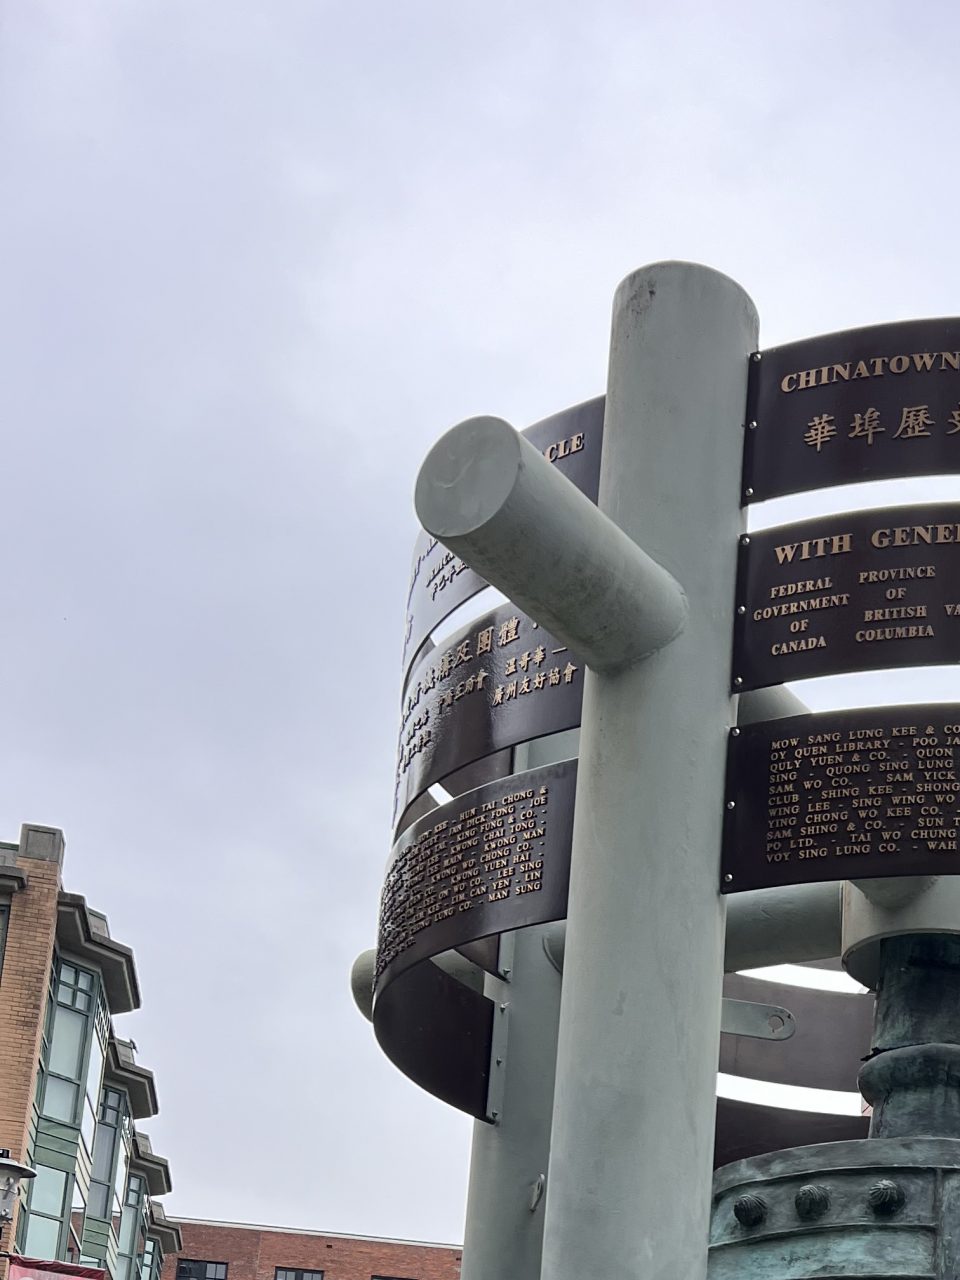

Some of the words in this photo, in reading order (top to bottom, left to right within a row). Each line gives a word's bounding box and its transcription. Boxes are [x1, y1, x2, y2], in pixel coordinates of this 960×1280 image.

[774, 533, 853, 565] WITH
[859, 565, 936, 584] PROVINCE
[770, 577, 833, 599] FEDERAL
[886, 588, 907, 600] OF
[753, 593, 850, 622] GOVERNMENT
[864, 605, 927, 622] BRITISH
[790, 619, 809, 634] OF
[855, 624, 935, 642] COLUMBIA
[771, 635, 827, 656] CANADA
[771, 738, 800, 750] MOW
[808, 732, 841, 744] SANG
[849, 728, 883, 740] LUNG
[892, 726, 917, 736] KEE
[925, 725, 935, 735] &
[794, 745, 828, 758] QUEN
[836, 739, 891, 753] LIBRARY
[912, 737, 938, 747] POO
[769, 772, 798, 783] SING
[826, 763, 870, 777] QUONG
[879, 761, 909, 771] SING
[918, 760, 954, 769] LUNG
[502, 789, 534, 805] CHONG
[768, 794, 799, 806] CLUB
[821, 787, 860, 799] SHING
[868, 785, 893, 795] KEE
[916, 783, 960, 793] SHONG
[491, 805, 515, 819] FONG
[530, 796, 546, 808] JOE
[483, 828, 505, 842] CHAI
[510, 820, 535, 834] TONG
[484, 835, 517, 852] KWONG
[523, 828, 545, 840] MAN
[850, 833, 872, 843] TAI
[881, 831, 901, 840] WO
[911, 829, 957, 839] CHUNG
[512, 852, 530, 864] HAI
[798, 848, 828, 859] SING
[836, 844, 870, 856] LUNG
[878, 843, 901, 852] CO.
[927, 841, 957, 850] WAH
[497, 867, 514, 879] LEE
[520, 860, 543, 873] SING
[492, 879, 510, 891] YEN
[525, 871, 542, 883] LIN
[488, 890, 509, 902] MAN
[515, 882, 542, 895] SUNG
